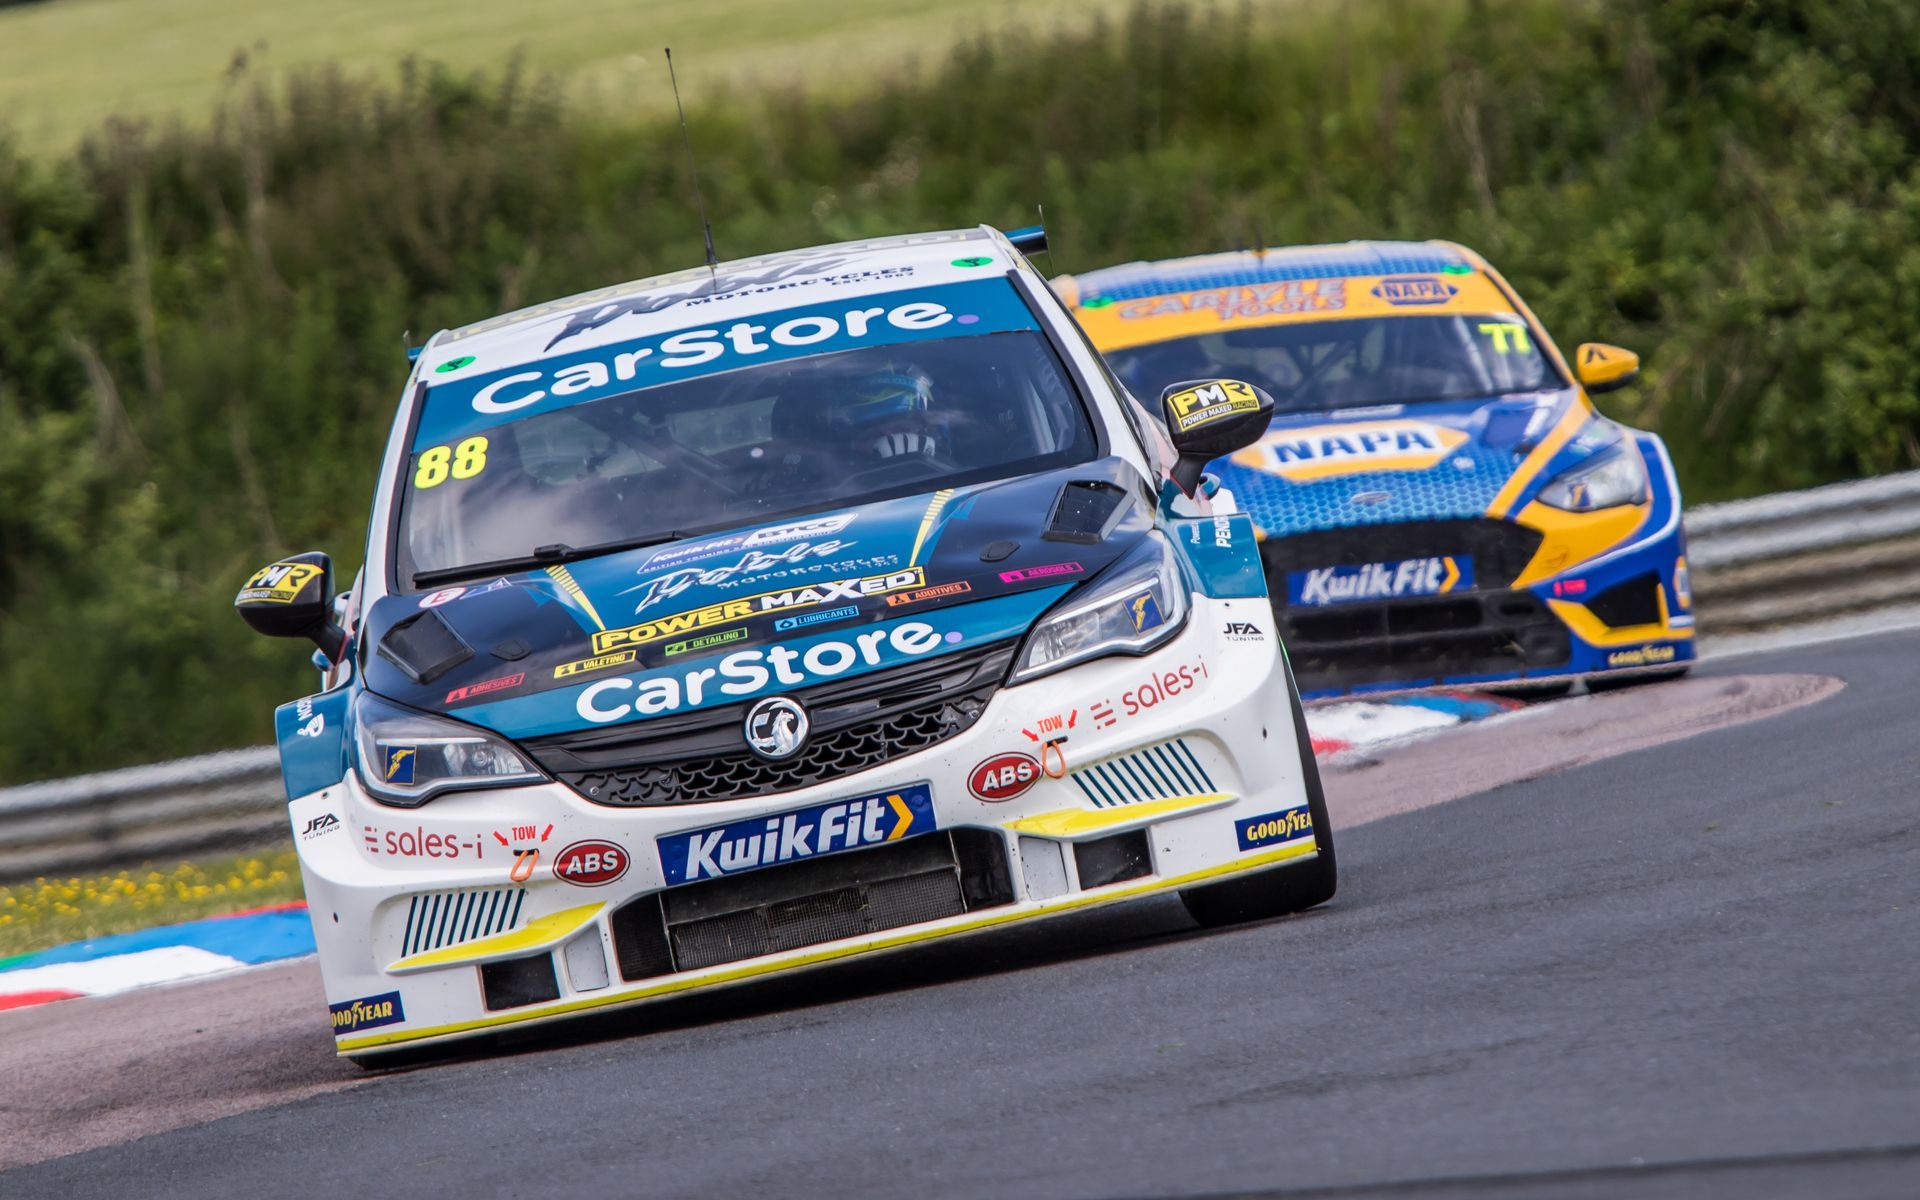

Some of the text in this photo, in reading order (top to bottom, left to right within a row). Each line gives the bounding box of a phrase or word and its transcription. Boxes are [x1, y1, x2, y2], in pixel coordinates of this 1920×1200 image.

[686, 266, 915, 307] MOTORCYCLES
[1385, 281, 1446, 297] NAPA
[1119, 278, 1346, 319] CARLYLE
[1218, 297, 1346, 320] TOOLS
[1478, 323, 1531, 354] 77
[1173, 382, 1252, 415] PMR
[1183, 400, 1258, 427] POWER MAXED RACING
[1273, 431, 1435, 463] NAPA
[414, 436, 488, 489] 88
[246, 565, 310, 588] PMR
[718, 554, 898, 588] MOTORCYCLES
[1028, 565, 1075, 577] AEROSOLS
[915, 584, 962, 599] ADDITIVES
[601, 571, 917, 649] POWER MAXED
[798, 608, 855, 625] LUBRICANTS
[693, 631, 739, 648] DETAILING
[1223, 622, 1263, 635] JFA
[583, 654, 626, 669] VALETING
[470, 677, 518, 694] ADHESIVES
[1122, 655, 1209, 717] sales-i
[1038, 715, 1063, 733] TOW
[981, 762, 1033, 792] ABS
[302, 813, 339, 835] JFA
[304, 824, 340, 841] TUNING
[512, 826, 536, 841] TOW
[385, 826, 483, 860] sales-i
[565, 849, 619, 876] ABS
